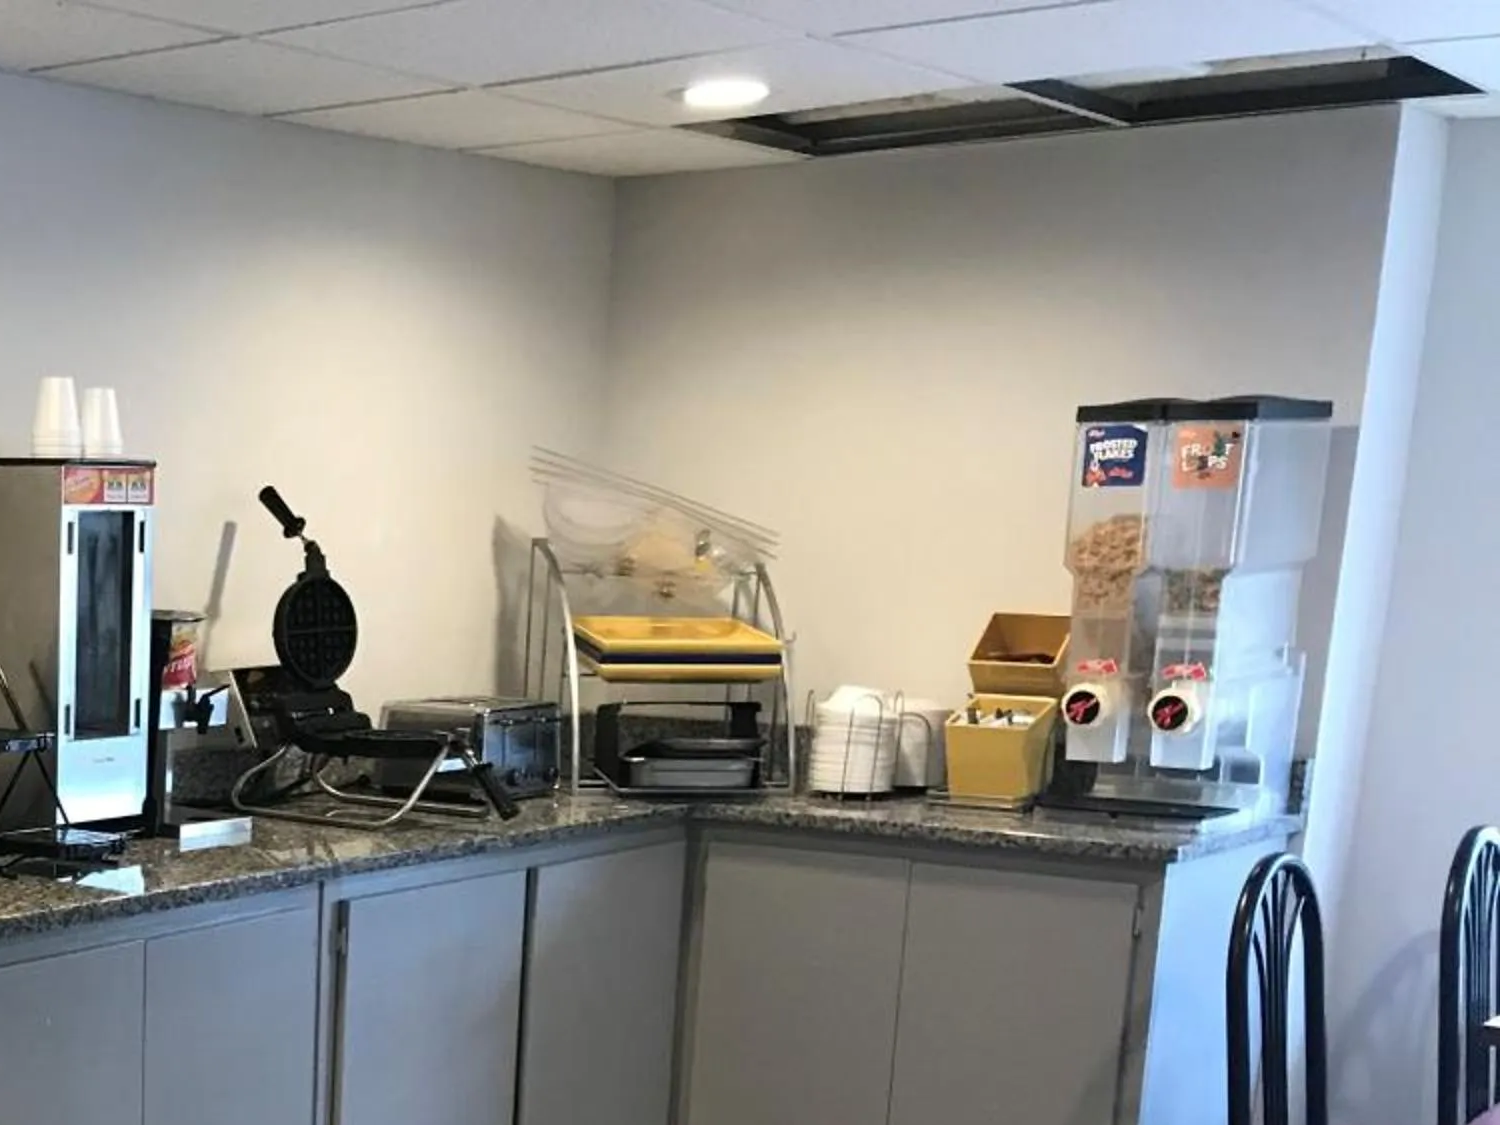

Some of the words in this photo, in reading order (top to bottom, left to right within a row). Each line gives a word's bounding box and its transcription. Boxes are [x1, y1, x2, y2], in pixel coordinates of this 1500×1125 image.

[1089, 438, 1138, 454] FROSTED
[1181, 443, 1234, 458] FROT
[1181, 455, 1229, 472] LPS
